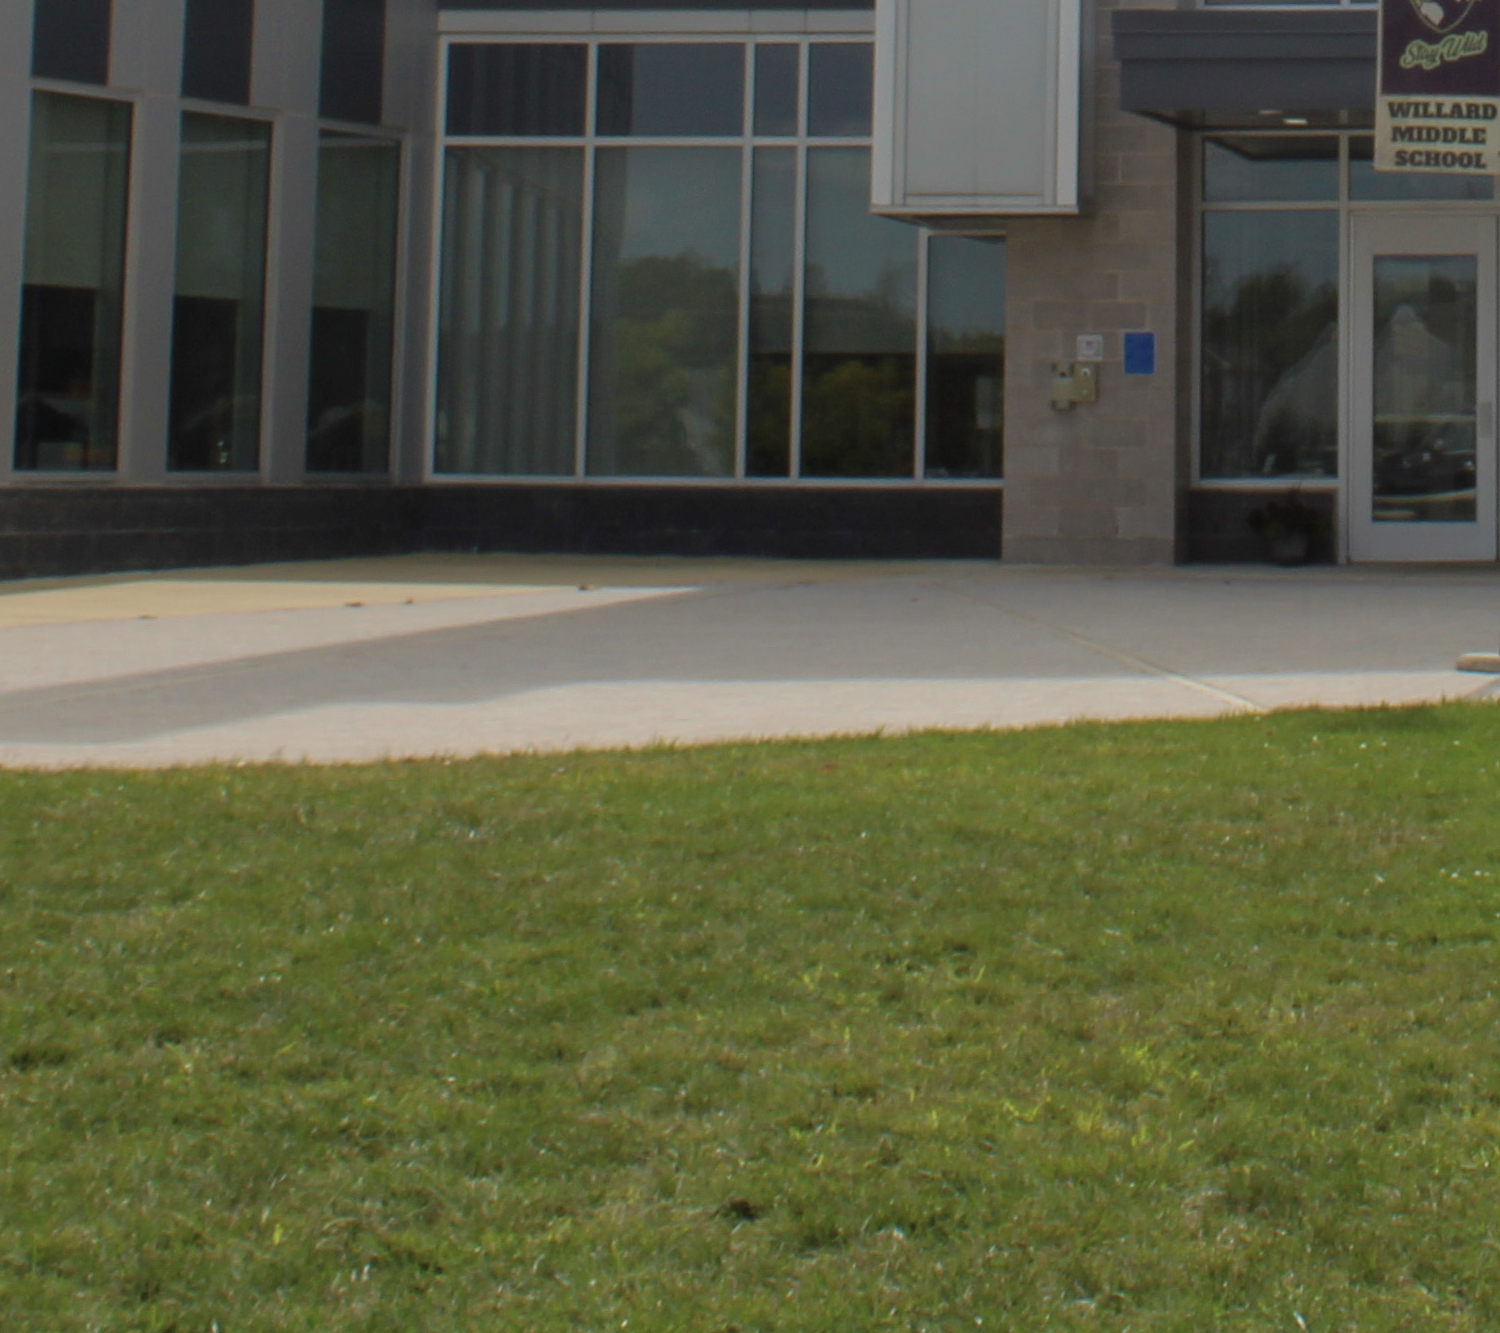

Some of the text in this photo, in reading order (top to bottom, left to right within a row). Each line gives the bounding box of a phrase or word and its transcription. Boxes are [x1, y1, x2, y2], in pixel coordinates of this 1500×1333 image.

[1401, 31, 1487, 70] Stay Wild
[1388, 102, 1497, 120] WILLARD
[1391, 126, 1487, 144] MIDDLE
[1395, 150, 1487, 168] SCHOOL
